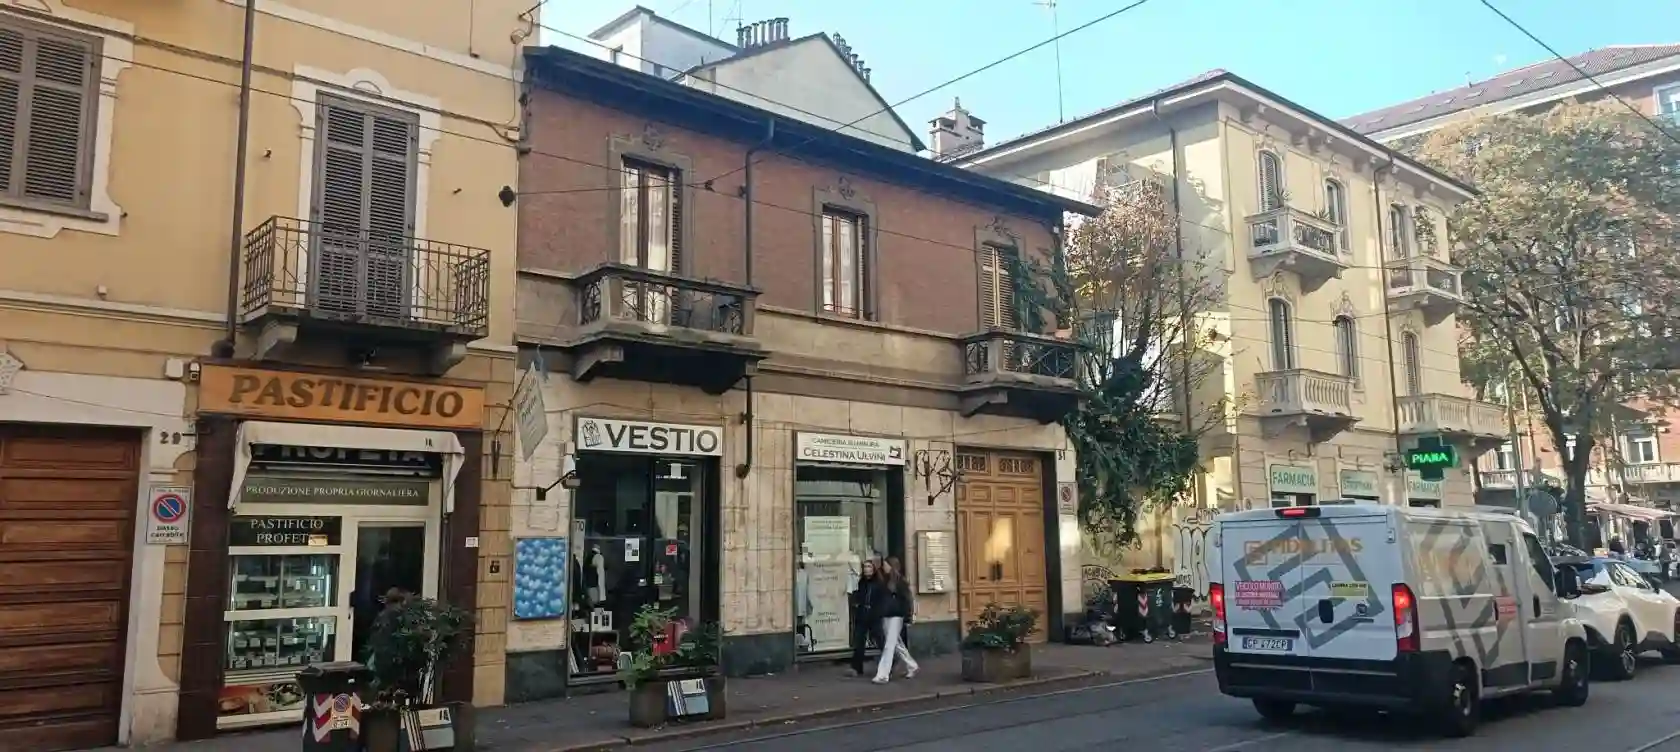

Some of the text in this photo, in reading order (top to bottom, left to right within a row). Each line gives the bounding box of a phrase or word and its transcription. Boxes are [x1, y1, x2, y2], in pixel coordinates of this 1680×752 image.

[228, 374, 464, 418] PASTIFICIO
[604, 423, 718, 453] VESTIO
[803, 446, 886, 462] CELESTINA ULVINI
[1272, 471, 1316, 487] FARMACIA
[246, 486, 419, 497] PRODUZIONE PROPRIA GIORNALIERA
[250, 519, 324, 529] PASTIFICIO
[256, 533, 310, 544] PROFET
